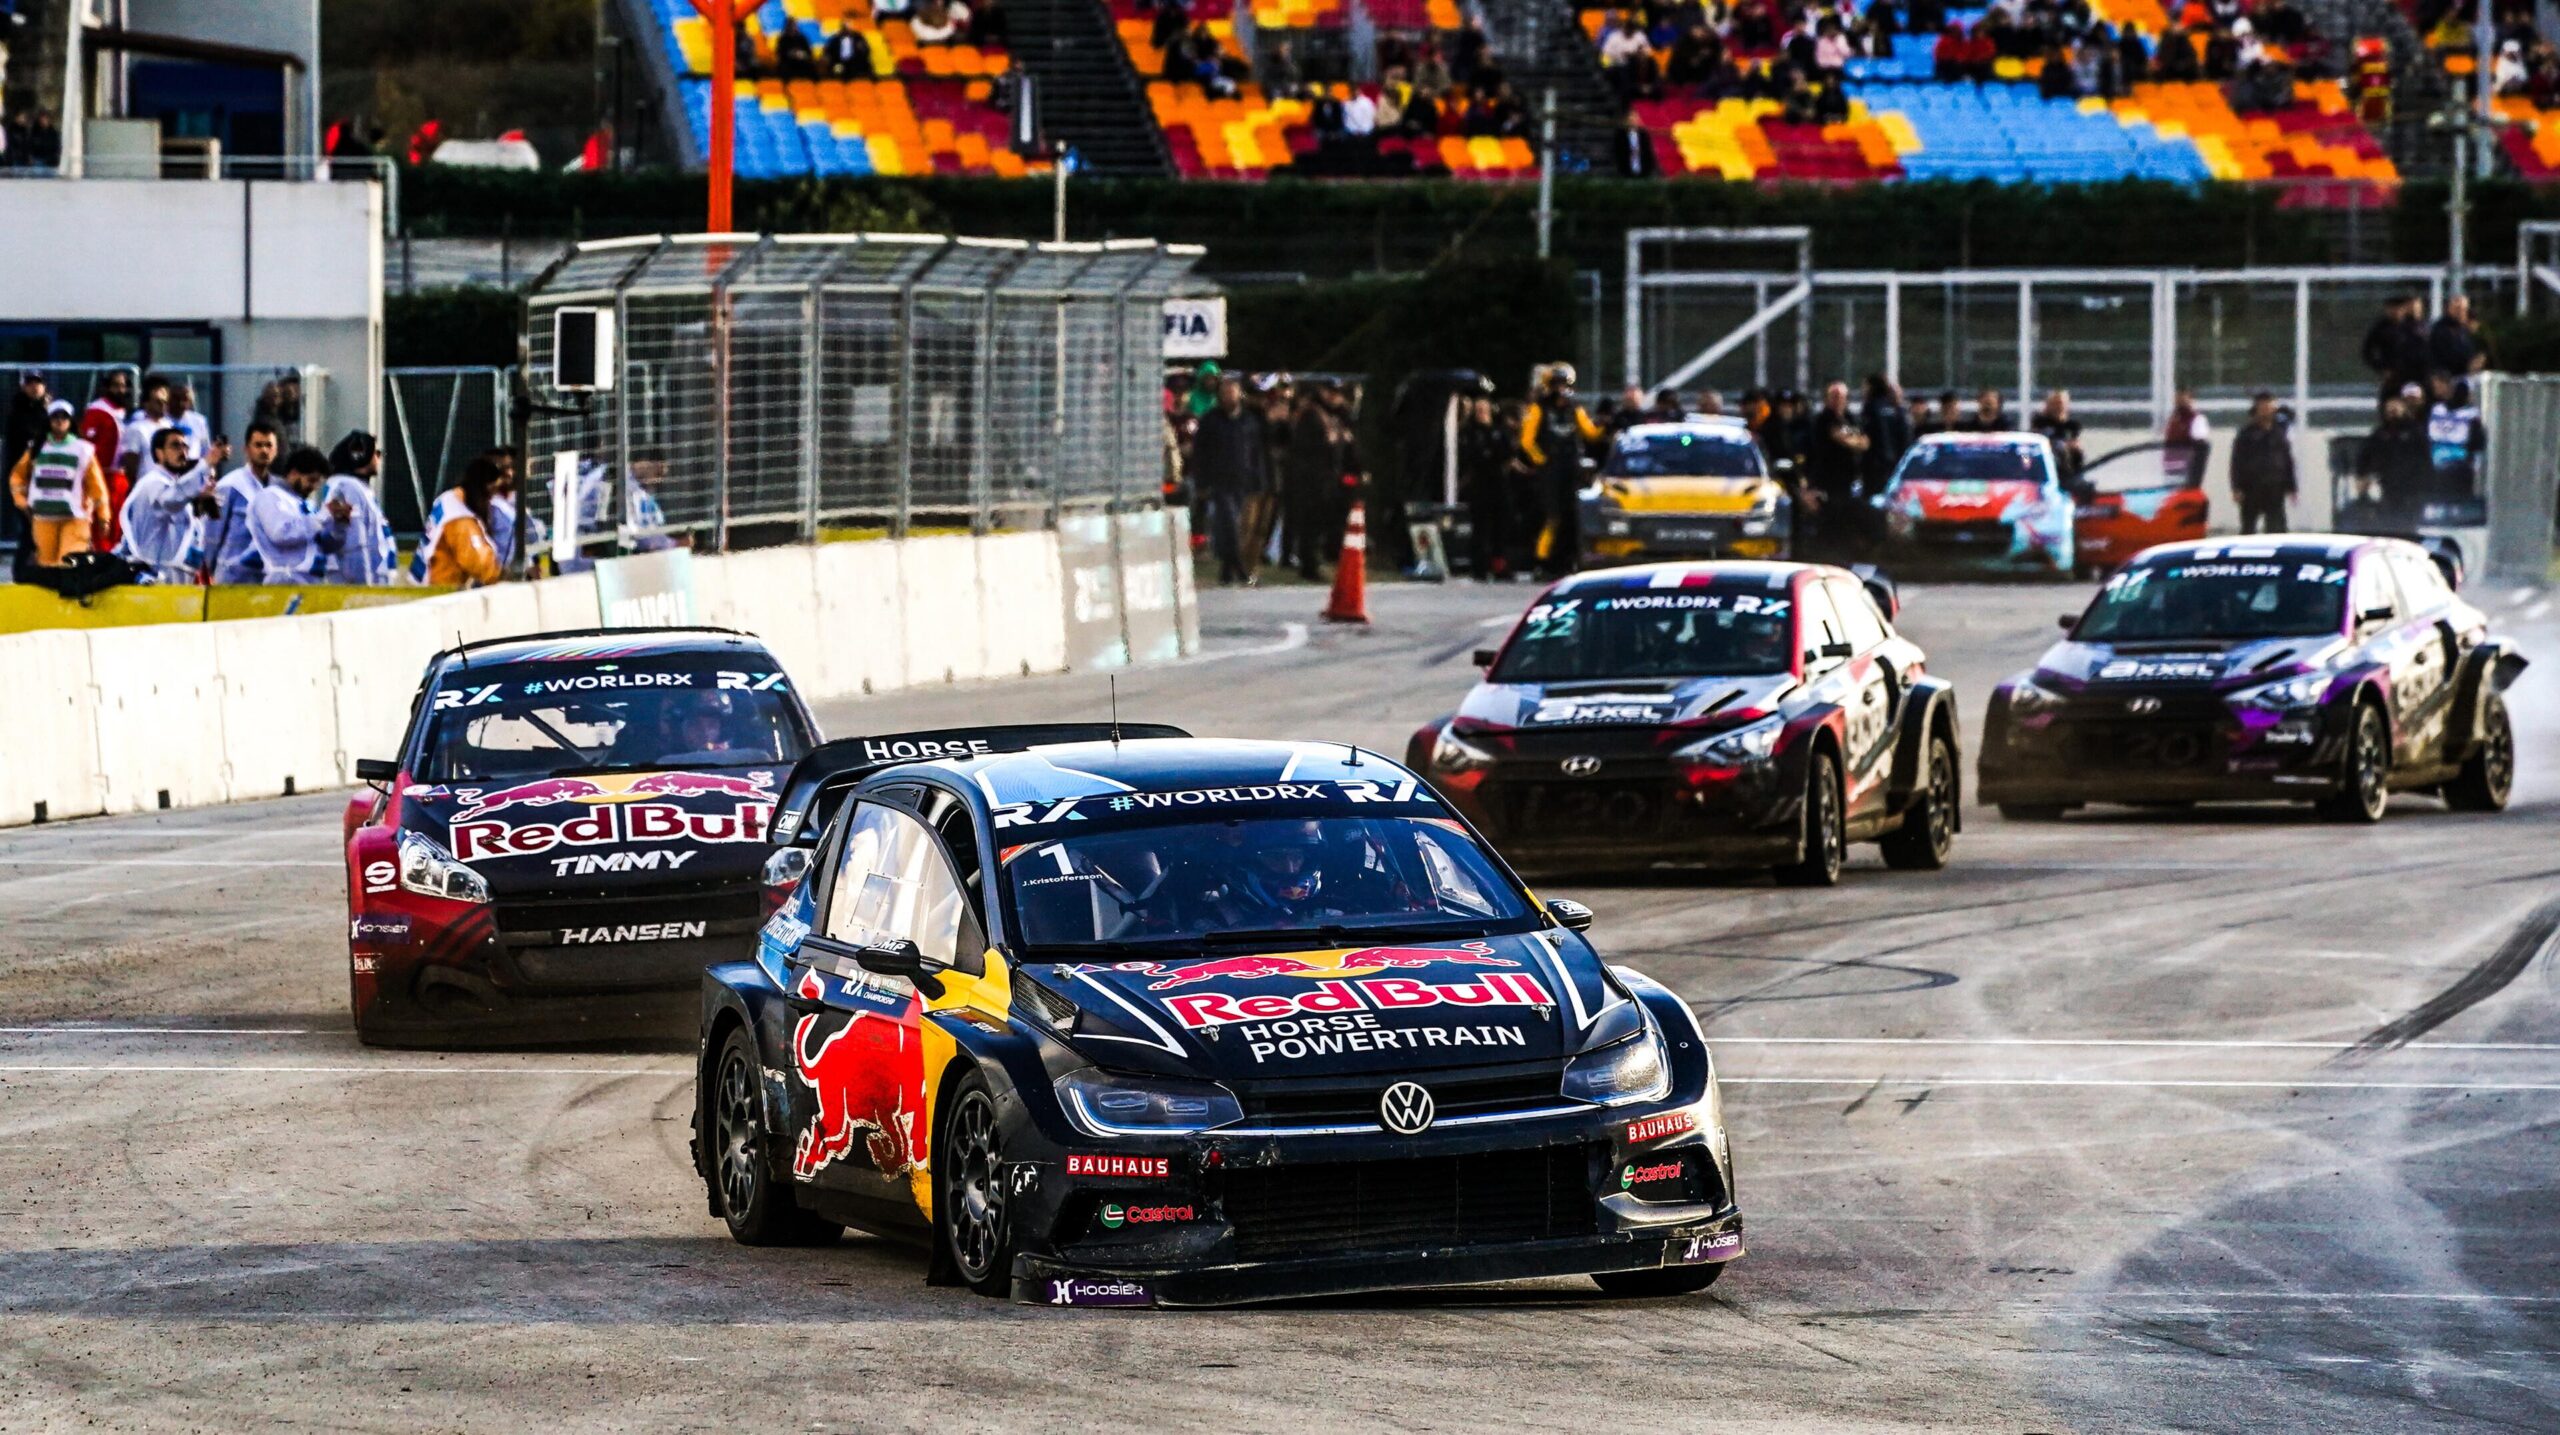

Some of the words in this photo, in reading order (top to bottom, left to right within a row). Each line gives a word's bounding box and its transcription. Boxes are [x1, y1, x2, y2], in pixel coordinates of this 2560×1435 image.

[1164, 314, 1209, 336] FIA
[1595, 595, 1723, 611] #WORLDRX
[1525, 617, 1577, 641] 22
[523, 672, 693, 695] #WORLDRX
[716, 670, 789, 692] RX
[433, 683, 503, 710] RX
[863, 739, 993, 761] HORSE
[1109, 782, 1328, 812] #WORLDRX
[1334, 779, 1438, 803] RX
[992, 796, 1089, 829] RX
[450, 803, 621, 864] Red
[624, 801, 774, 844] Bul
[550, 850, 698, 878] TIMMY
[1038, 842, 1075, 876] 1
[1021, 873, 1104, 888] J.Kristoffersson
[560, 920, 707, 947] HANSEN
[1160, 979, 1369, 1030] Red
[1355, 973, 1557, 1010] Bull
[1240, 1013, 1382, 1042] HORSE
[1249, 1025, 1527, 1064] POWERTRAIN
[1628, 1113, 1694, 1142] BAUHAUS
[1068, 1157, 1169, 1176] BAUHAUS
[1633, 1161, 1685, 1184] Castrol
[1126, 1204, 1194, 1224] Castrol
[1074, 1284, 1144, 1297] HOOSIER
